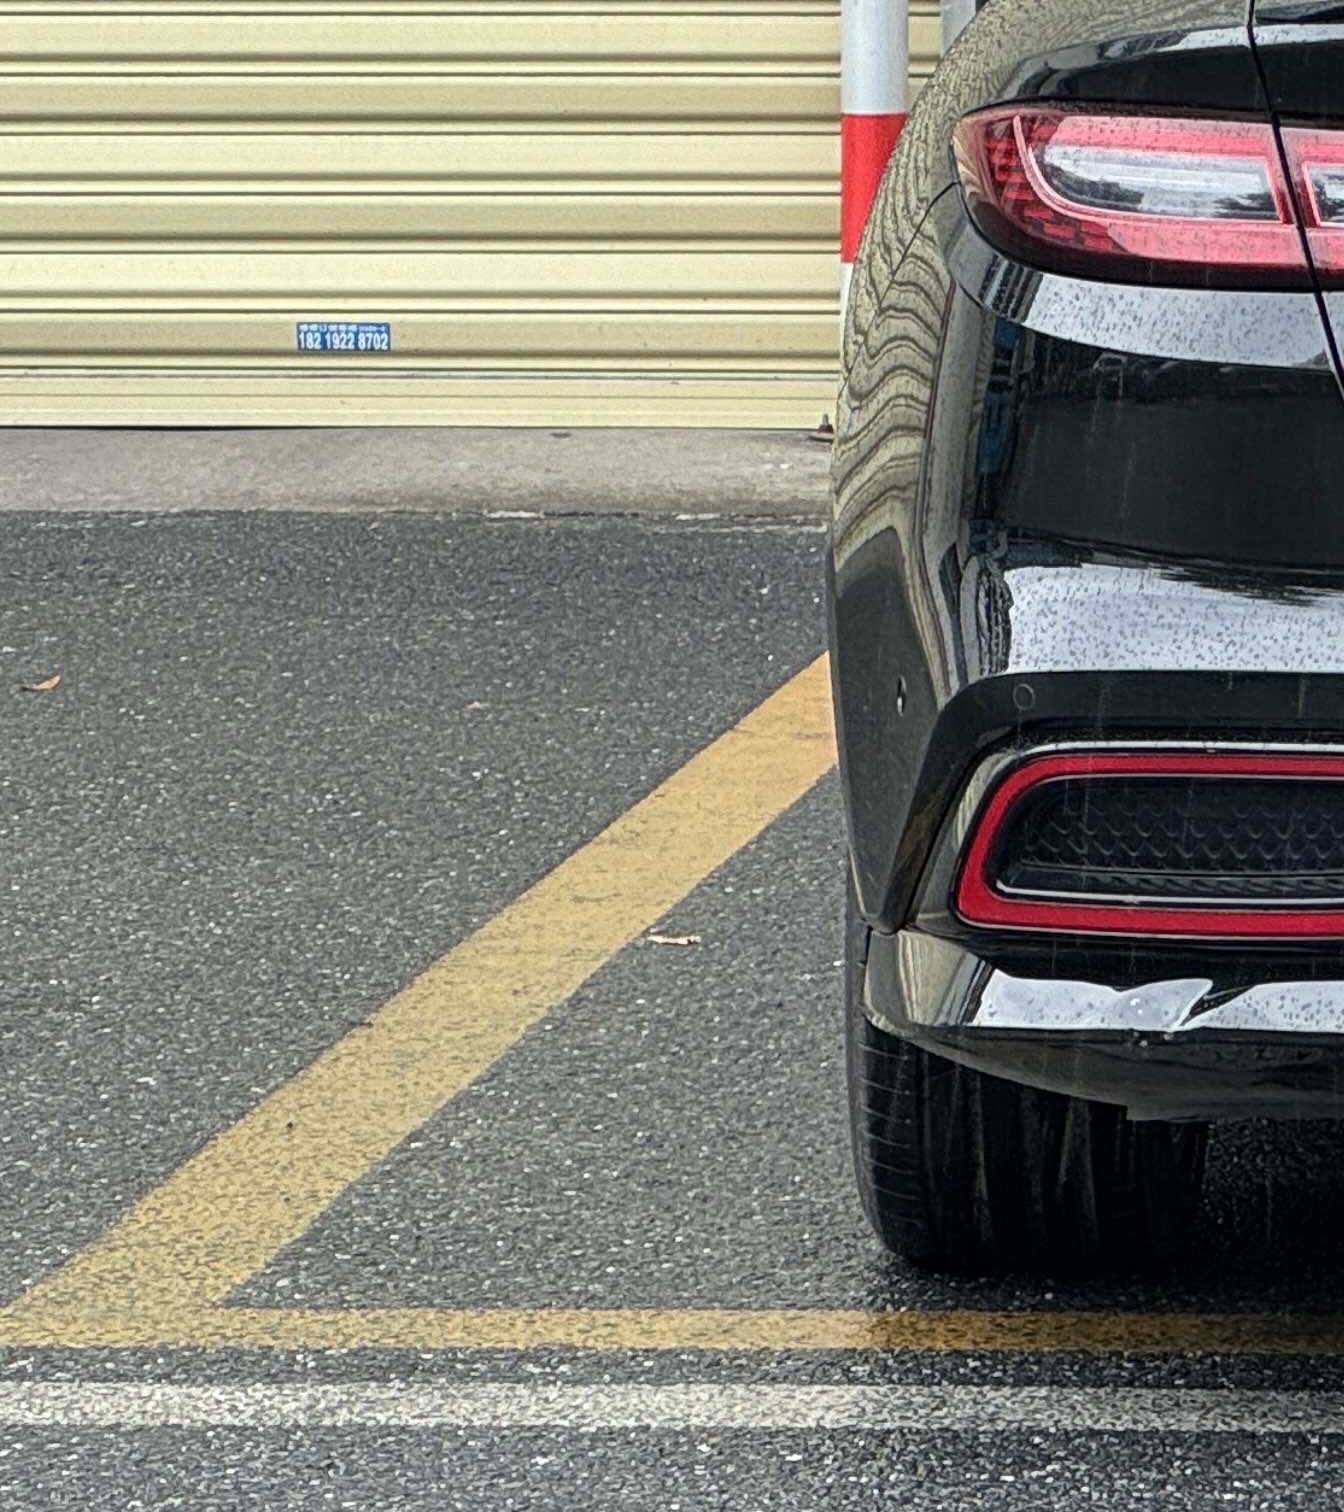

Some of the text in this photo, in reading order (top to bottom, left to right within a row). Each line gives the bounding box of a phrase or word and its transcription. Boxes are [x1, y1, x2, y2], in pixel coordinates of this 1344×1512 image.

[299, 332, 389, 352] 182 1922 8702
